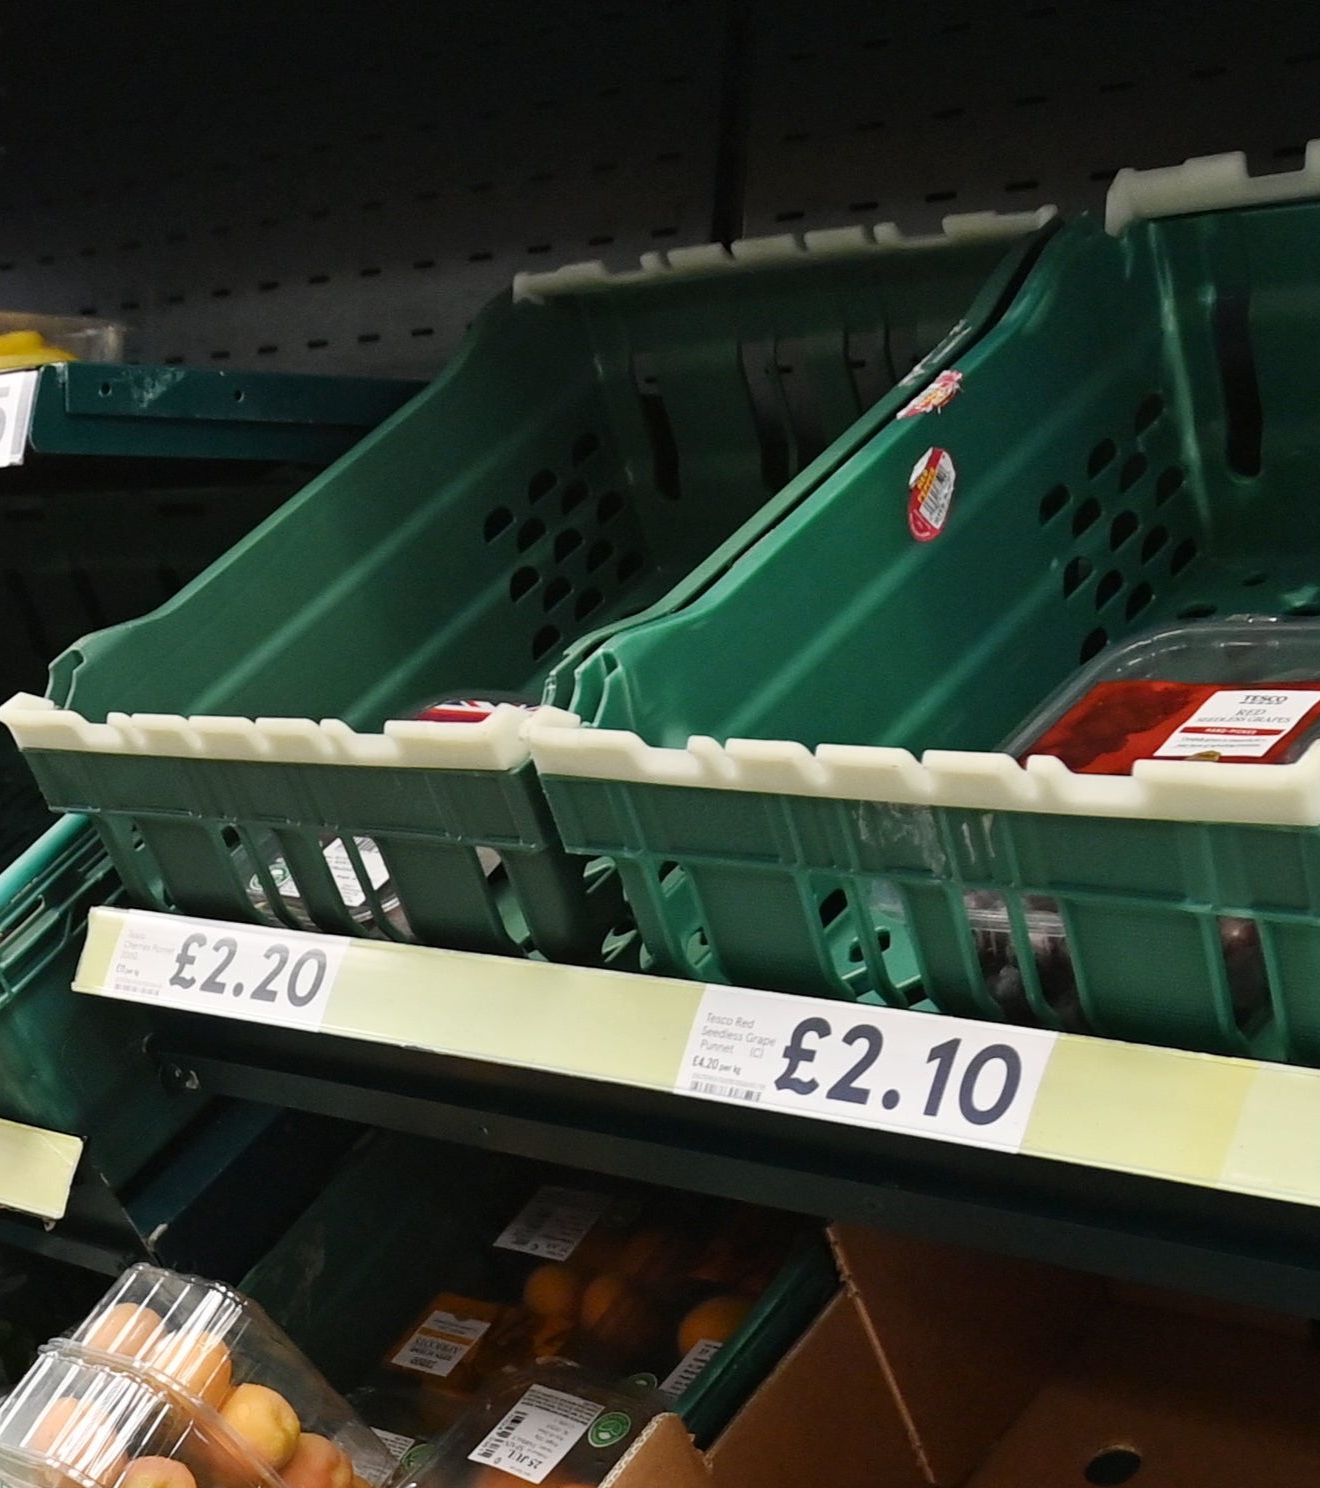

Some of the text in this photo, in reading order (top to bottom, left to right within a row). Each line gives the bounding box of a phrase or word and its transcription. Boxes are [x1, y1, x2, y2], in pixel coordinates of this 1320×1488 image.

[1241, 694, 1289, 704] TESCO
[1235, 708, 1268, 716] RED
[168, 932, 328, 1008] £2.20
[706, 1012, 755, 1029] Tesco Red
[701, 1025, 777, 1047] Seedless Grape
[700, 1038, 735, 1054] Punnet
[691, 1055, 720, 1070] £4.20
[773, 1016, 1023, 1127] £2.10
[527, 1459, 544, 1470] 25
